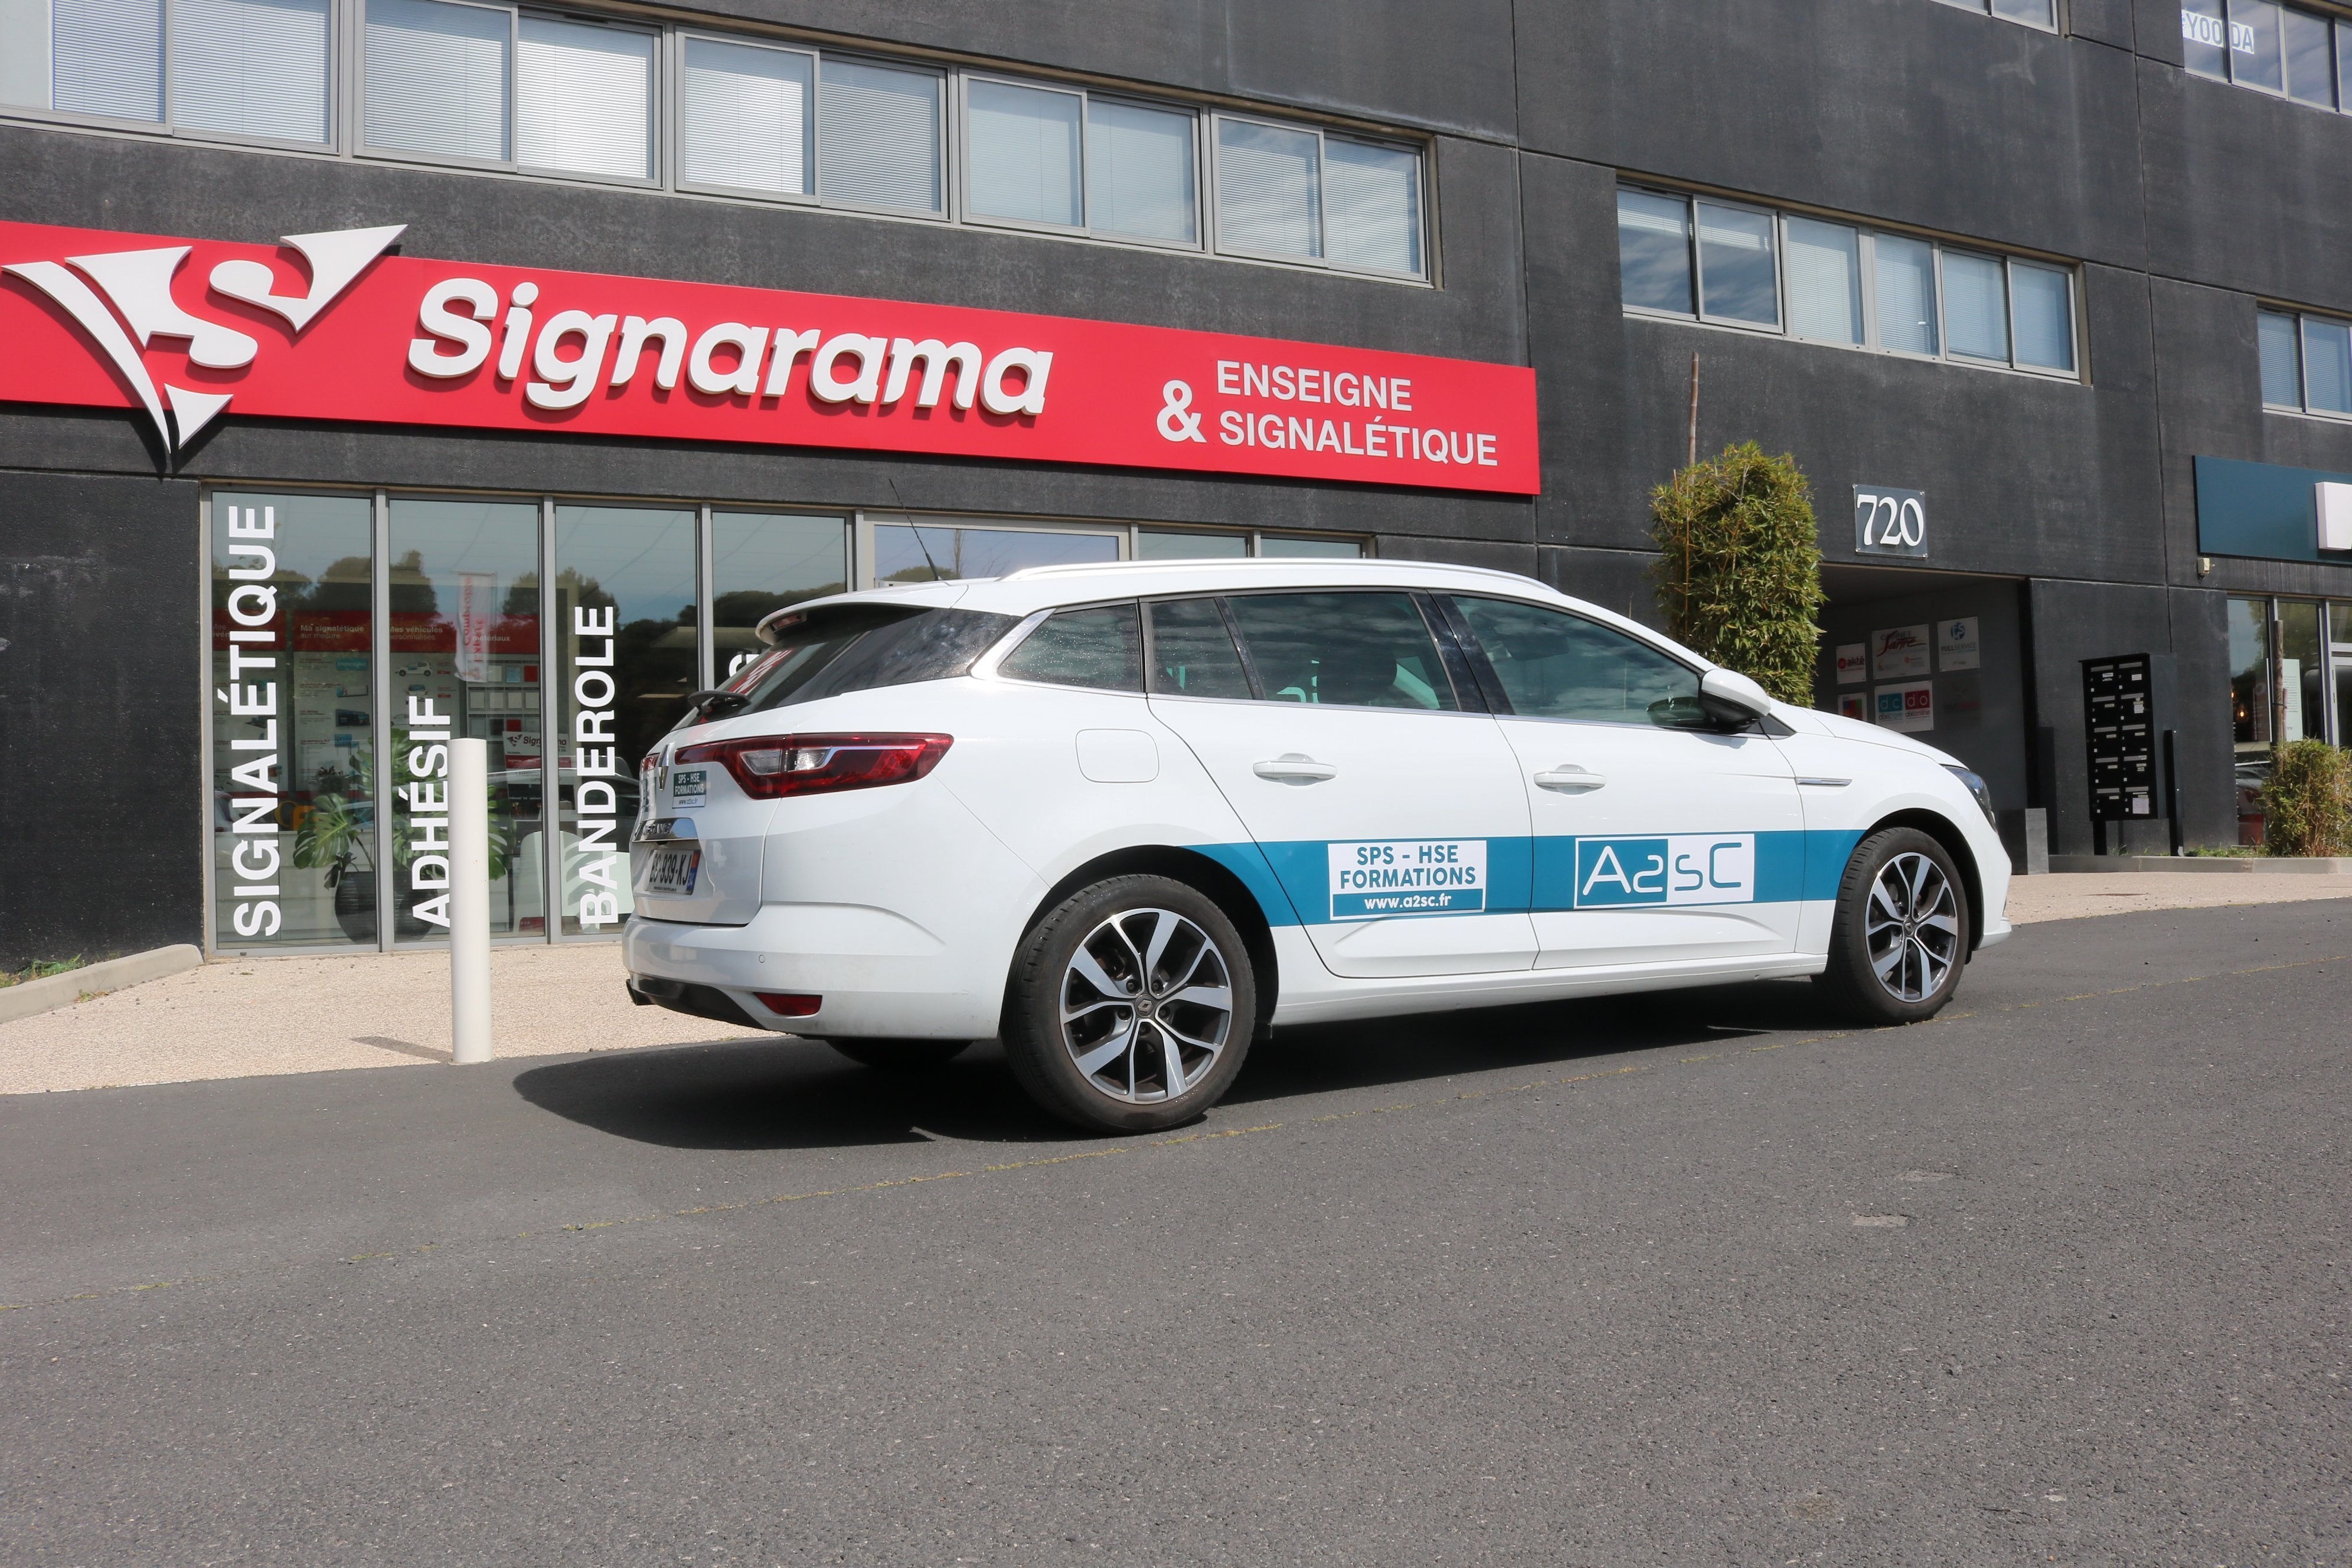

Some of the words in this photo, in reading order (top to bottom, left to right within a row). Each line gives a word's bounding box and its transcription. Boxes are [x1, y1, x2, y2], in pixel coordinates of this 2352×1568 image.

[407, 277, 1054, 415] Signarama
[1157, 379, 1207, 443] &
[1216, 360, 1413, 411] ENSEIGNE
[1219, 410, 1498, 466] SIGNALÉTIQUE
[1857, 494, 1925, 547] 720
[315, 624, 364, 634] signalétique
[218, 505, 281, 936] SIGNALÉTIQUE
[574, 606, 619, 925] BANDEROLE
[675, 783, 704, 795] FORMATIONS
[398, 696, 451, 929] ADHÉSIF
[1340, 866, 1476, 889] FORMATIONS
[1357, 846, 1394, 865] SPS
[1419, 845, 1459, 864] HSE
[1364, 893, 1452, 910] www.a2sc.fr
